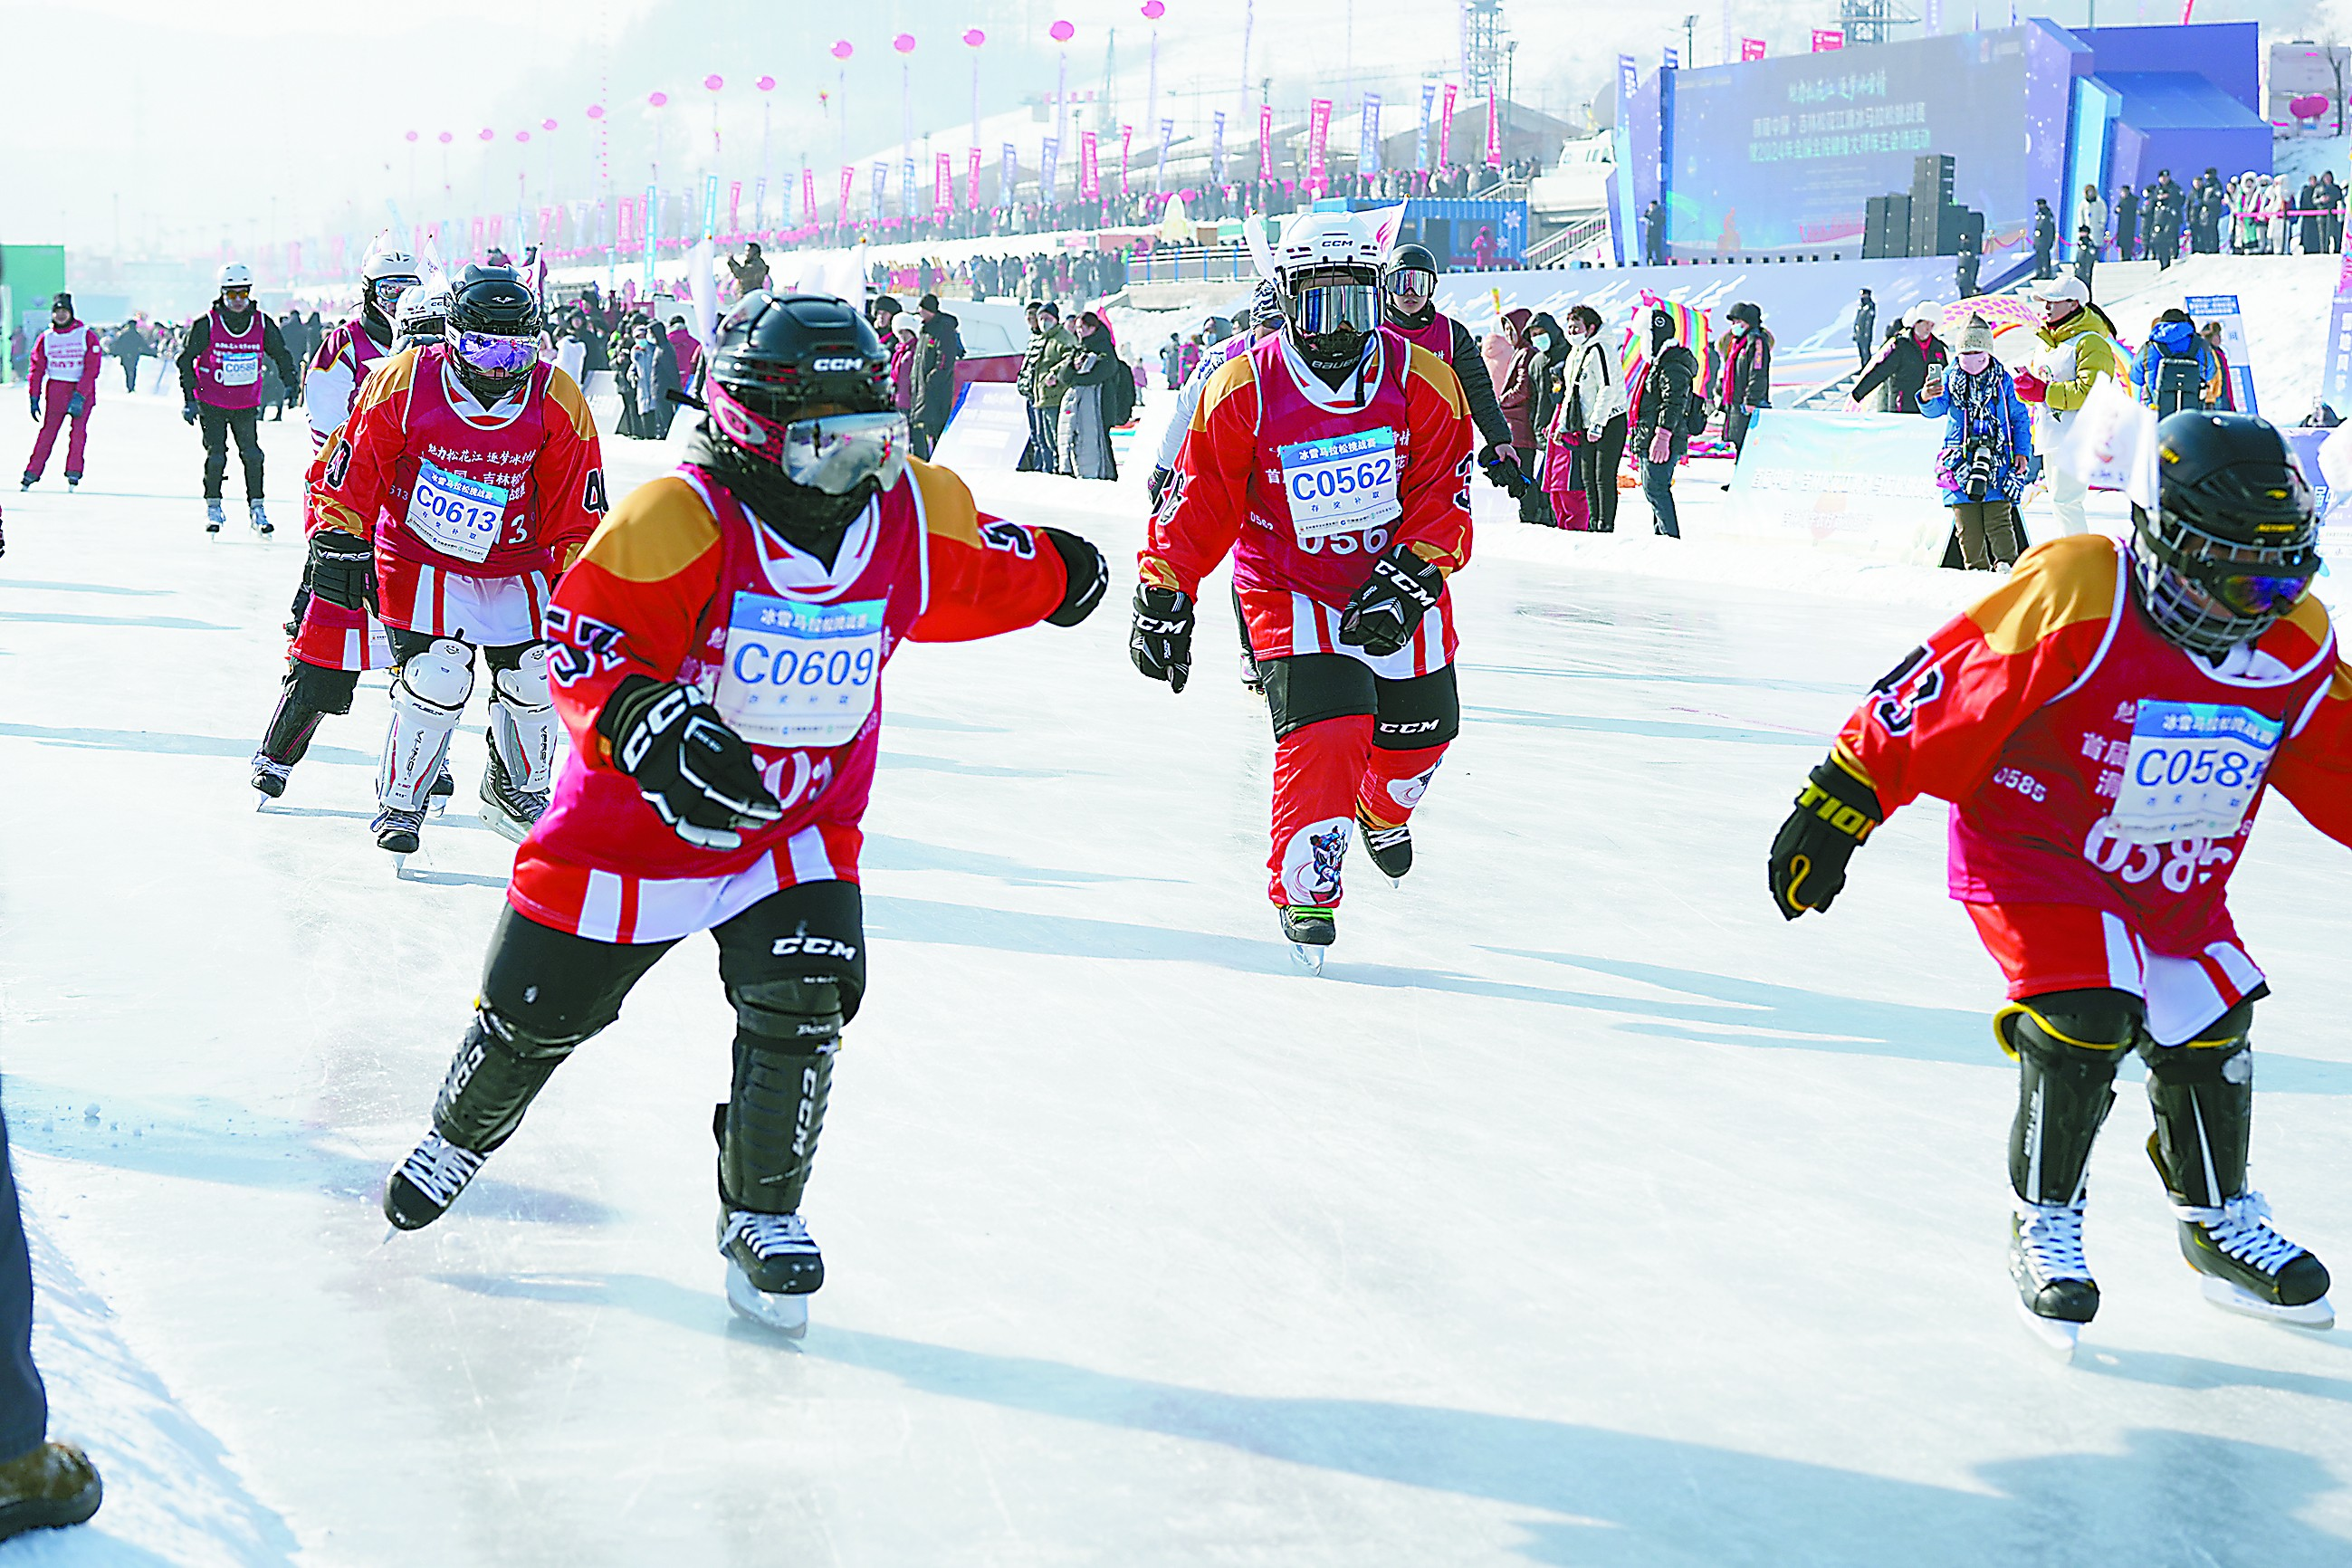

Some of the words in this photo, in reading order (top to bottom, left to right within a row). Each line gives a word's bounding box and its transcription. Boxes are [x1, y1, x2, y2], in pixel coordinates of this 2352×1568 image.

[813, 358, 865, 372] CCM
[1299, 437, 1376, 461] 冰雪马拉松挑战赛
[431, 473, 493, 500] 冰雪马拉松挑战赛
[1293, 458, 1392, 501] C0562
[416, 484, 497, 532] C0613
[1374, 559, 1437, 607] CCM
[733, 643, 874, 686] C0609
[1380, 719, 1439, 733] CCM
[1993, 767, 2047, 802] 0585
[771, 937, 856, 960] CCM
[792, 1066, 817, 1157] CCM
